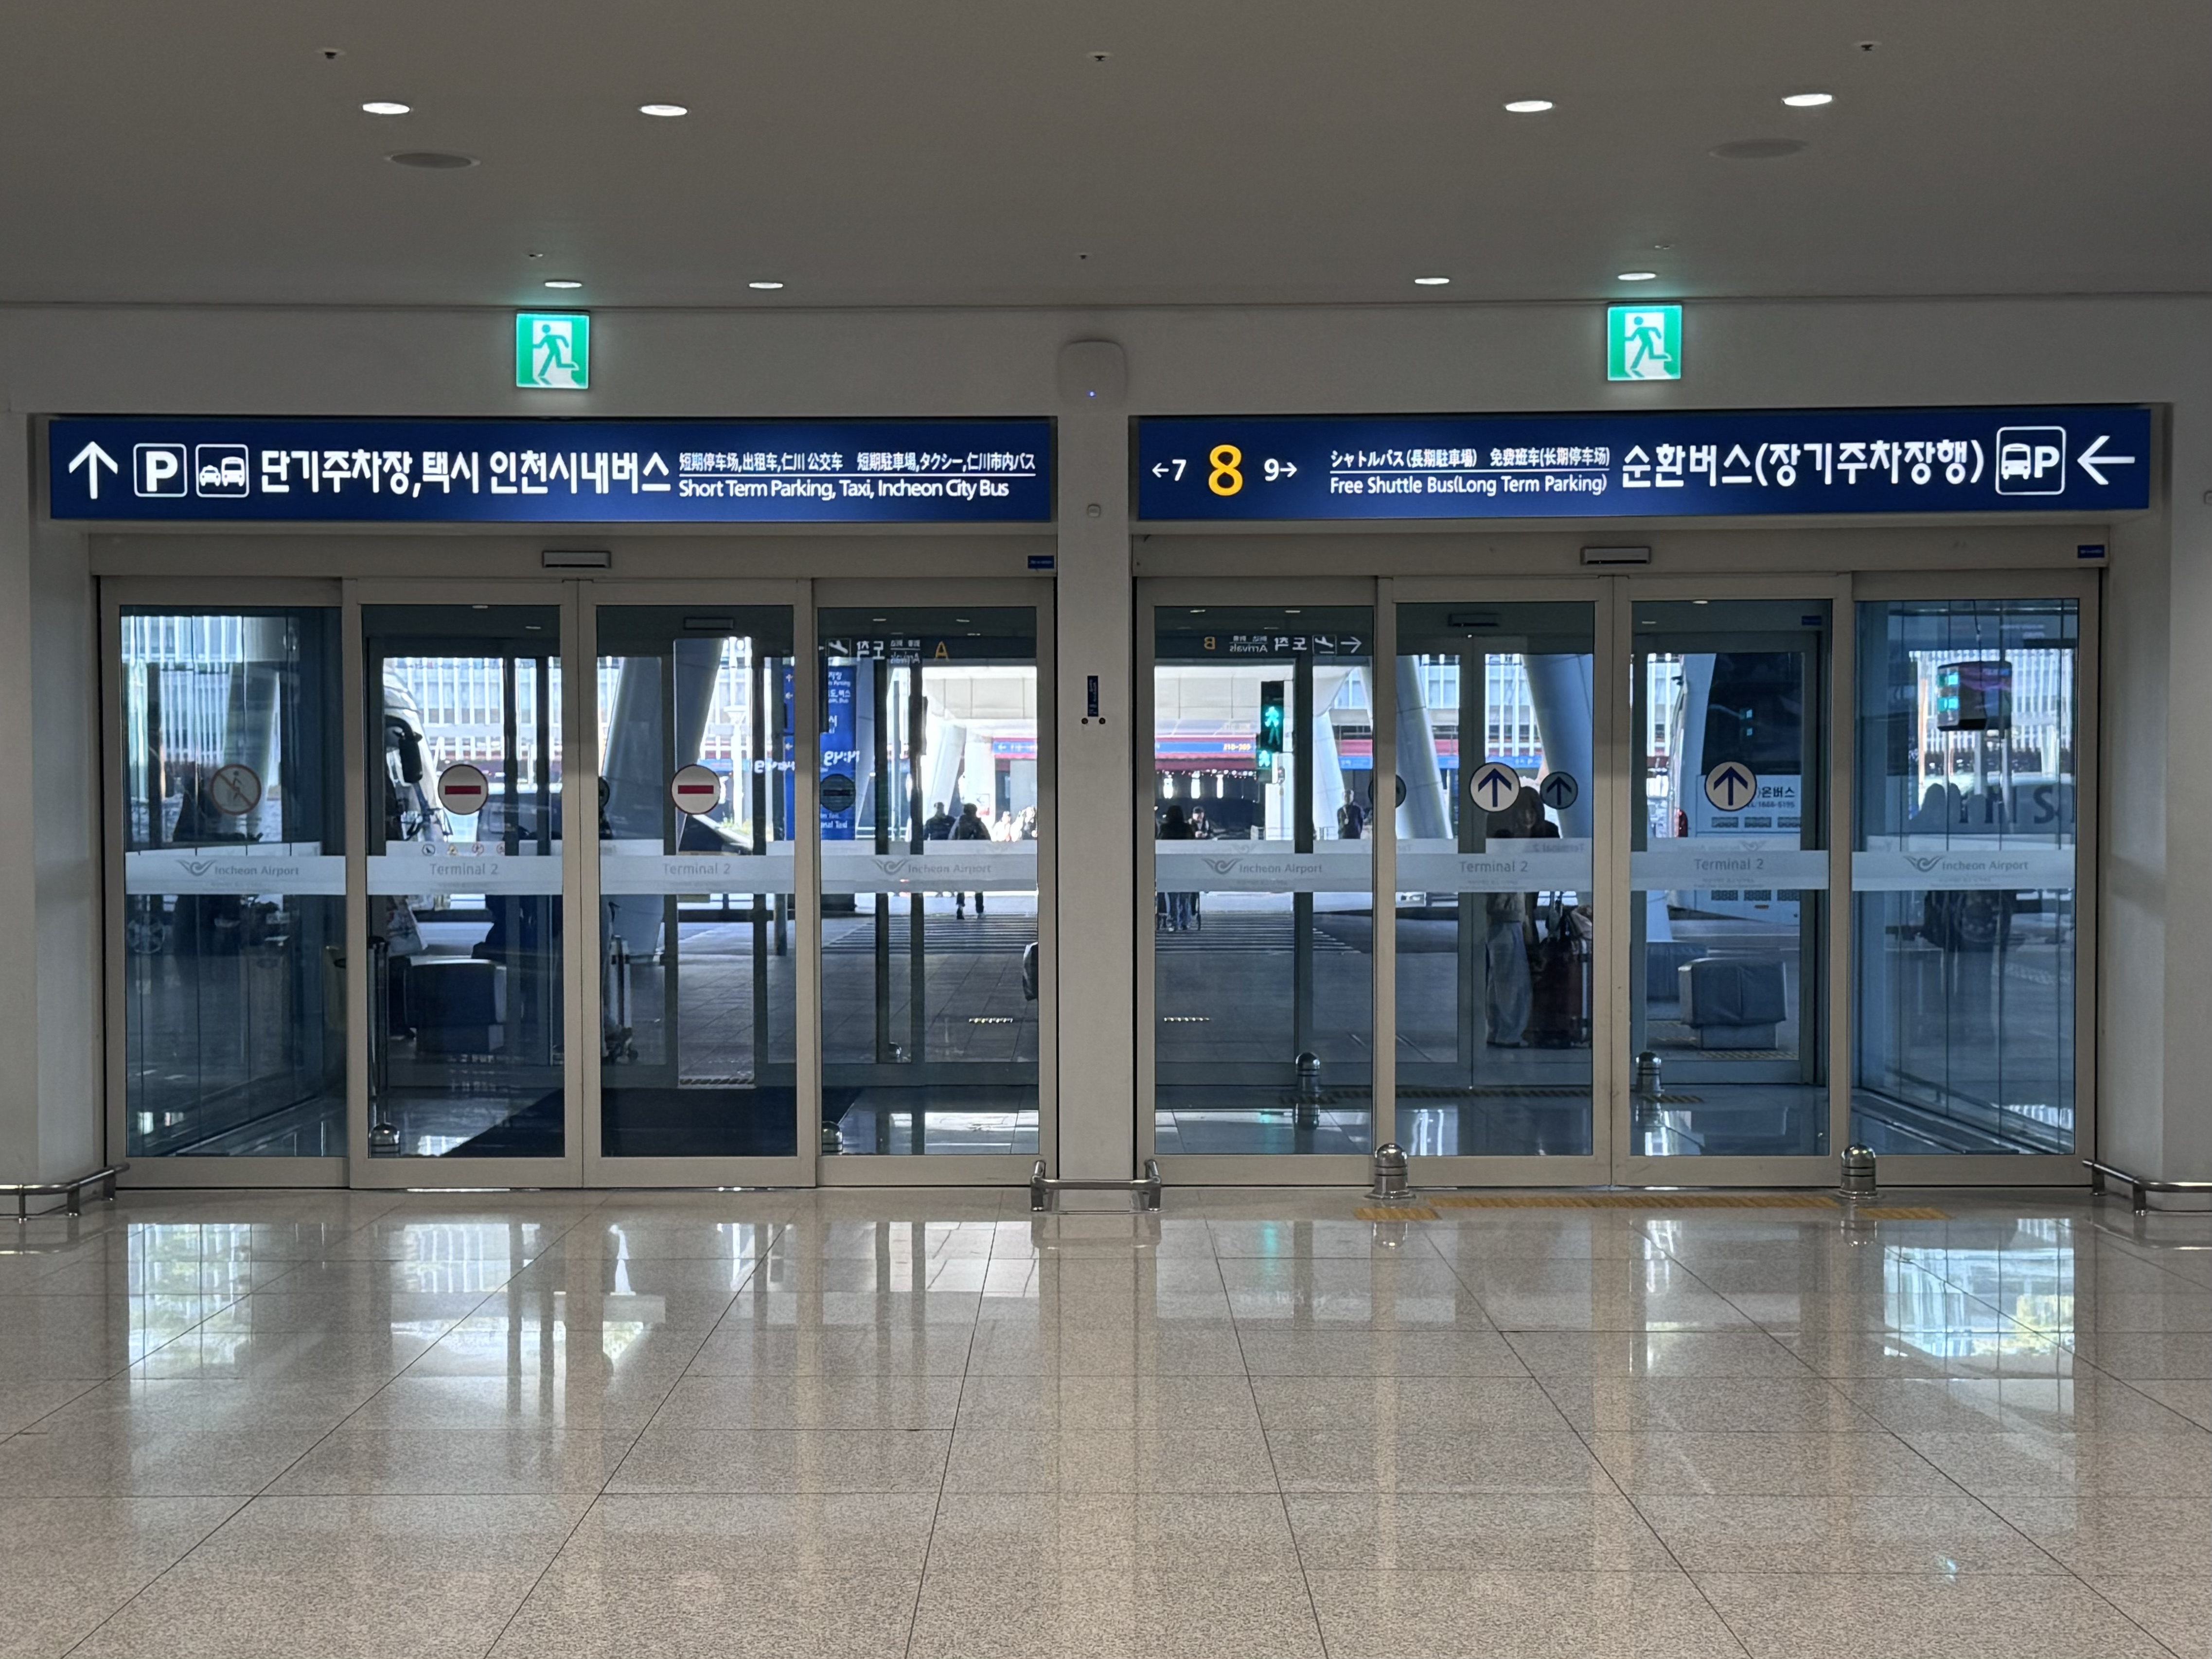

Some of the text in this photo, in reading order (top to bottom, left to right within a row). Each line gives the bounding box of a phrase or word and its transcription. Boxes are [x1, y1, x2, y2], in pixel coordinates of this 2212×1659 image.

[1622, 439, 1984, 488] 순환버스(장기주차장행)
[2034, 446, 2060, 478] P
[145, 451, 178, 492] P
[262, 449, 671, 498] 단기주차장,택시 인천시내버스
[1172, 444, 1279, 496] 7 8 9
[679, 478, 1009, 501] Short Term Parking, Taxi, Incheon City Bus
[1330, 477, 1363, 494] Free
[1367, 476, 1422, 494] Shuttle
[1501, 476, 1540, 493] Term
[1545, 474, 1607, 495] Parking)
[430, 863, 499, 875] Terminal 2
[662, 863, 731, 875] Terminal 2
[908, 864, 991, 875] Incheon Airport
[1240, 864, 1322, 875] Incheon Airport
[1459, 860, 1528, 873] Terminal 2
[1694, 858, 1764, 870] Terminal 2
[1942, 861, 2028, 872] Incheon Airport
[214, 865, 299, 877] Incheon Airport
